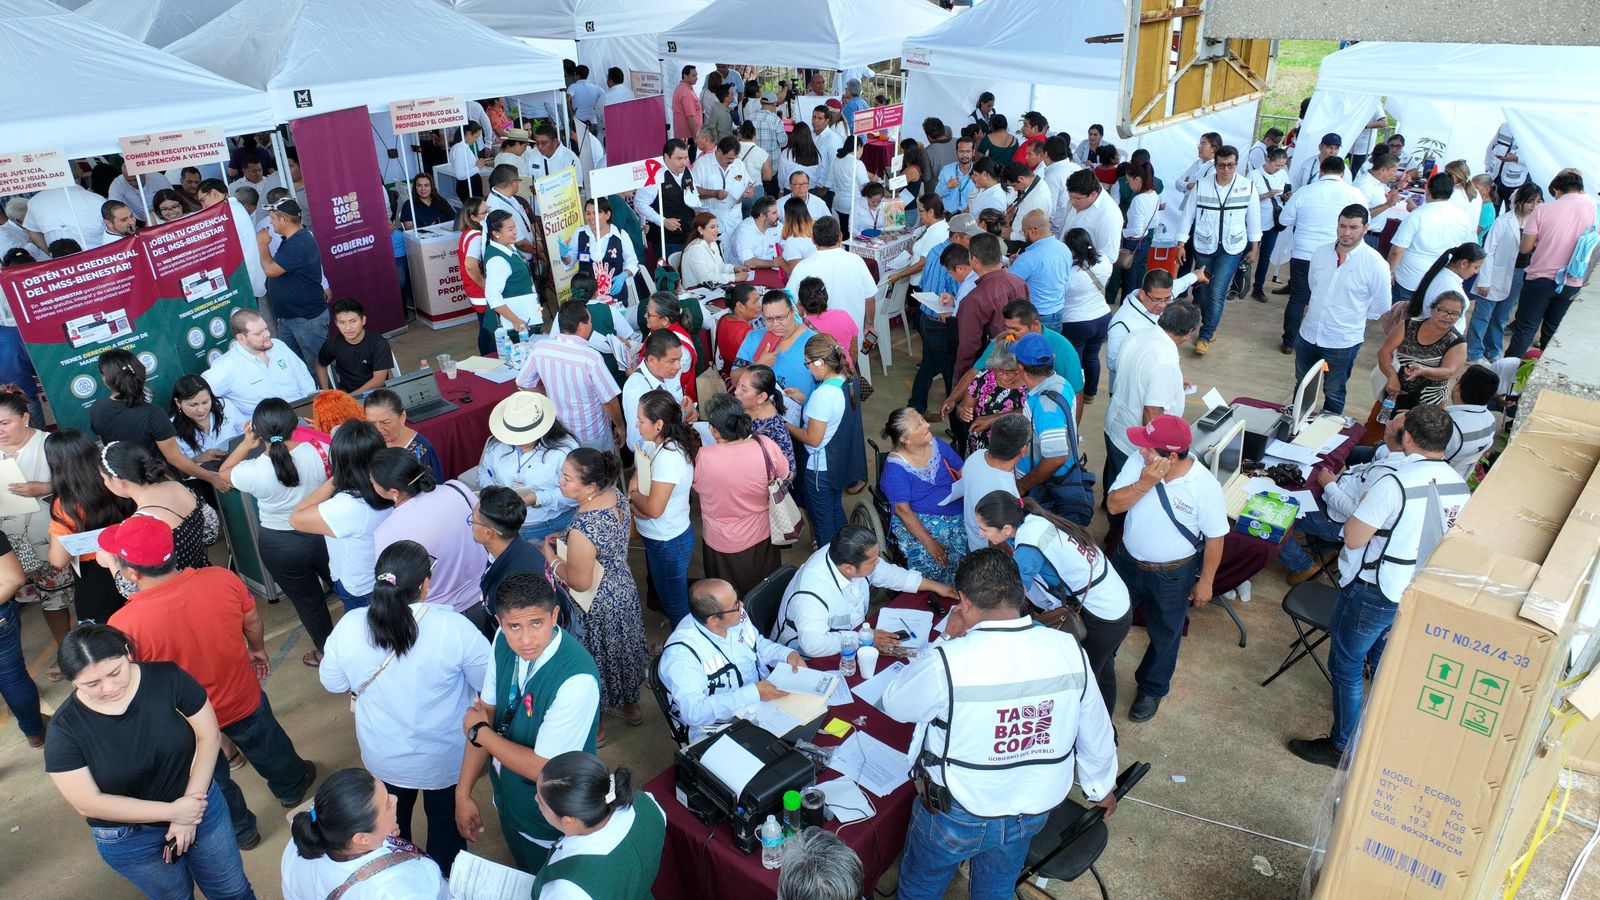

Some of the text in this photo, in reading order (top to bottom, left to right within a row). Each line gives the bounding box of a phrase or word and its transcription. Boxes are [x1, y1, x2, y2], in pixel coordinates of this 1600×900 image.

[395, 120, 426, 129] PROPIEDAD
[438, 115, 464, 123] COMERCIO
[396, 113, 421, 121] REGISTRO
[422, 109, 444, 118] PÚBLICO
[125, 141, 226, 161] COMISIÓN EJECUTIVA ESTATAL
[147, 155, 181, 166] ATENCIÓN
[189, 149, 220, 159] VÍCTIMAS
[9, 166, 46, 178] JUSTICIA,
[26, 171, 65, 182] IGUALDAD
[12, 181, 47, 192] MUJERES
[331, 196, 344, 206] TA
[333, 203, 350, 216] BAS
[335, 214, 347, 225] CO
[543, 204, 571, 221] Prevención
[149, 213, 229, 249] ¡OBTÉN TU CREDENCIAL
[544, 211, 579, 236] Suicidio
[152, 225, 225, 257] DEL IMSS-BIENESTAR!
[331, 234, 375, 255] GOBIERNO
[22, 249, 139, 289] ¡OBTÉN TU CREDENCIAL
[25, 262, 132, 299] DEL IMSS-BIENESTAR!
[33, 306, 53, 315] médica
[74, 293, 92, 304] integral
[103, 285, 121, 295] calidad
[121, 282, 131, 290] para
[40, 290, 83, 306] IMSS-BIENESTAR
[83, 281, 116, 295] garantizamos
[35, 311, 56, 320] quienes
[64, 302, 84, 312] cuentan
[94, 292, 118, 304] seguridad
[194, 301, 214, 313] DERECHO
[60, 355, 82, 366] TIENES
[82, 345, 112, 359] DERECHO
[117, 335, 140, 347] RECIBIR
[1425, 623, 1531, 669] LOT NO:24/4-33
[997, 707, 1021, 723] TA
[1473, 709, 1486, 723] 3
[994, 720, 1034, 739] BAS
[993, 738, 1020, 754] CO
[1424, 786, 1462, 808] ECG800
[1412, 805, 1432, 819] 17.3
[1445, 819, 1467, 835] KGS
[1450, 809, 1465, 821] PC
[1408, 815, 1428, 829] 19.3
[1441, 830, 1463, 845] KGS
[1401, 824, 1463, 857] 89X21X87CM
